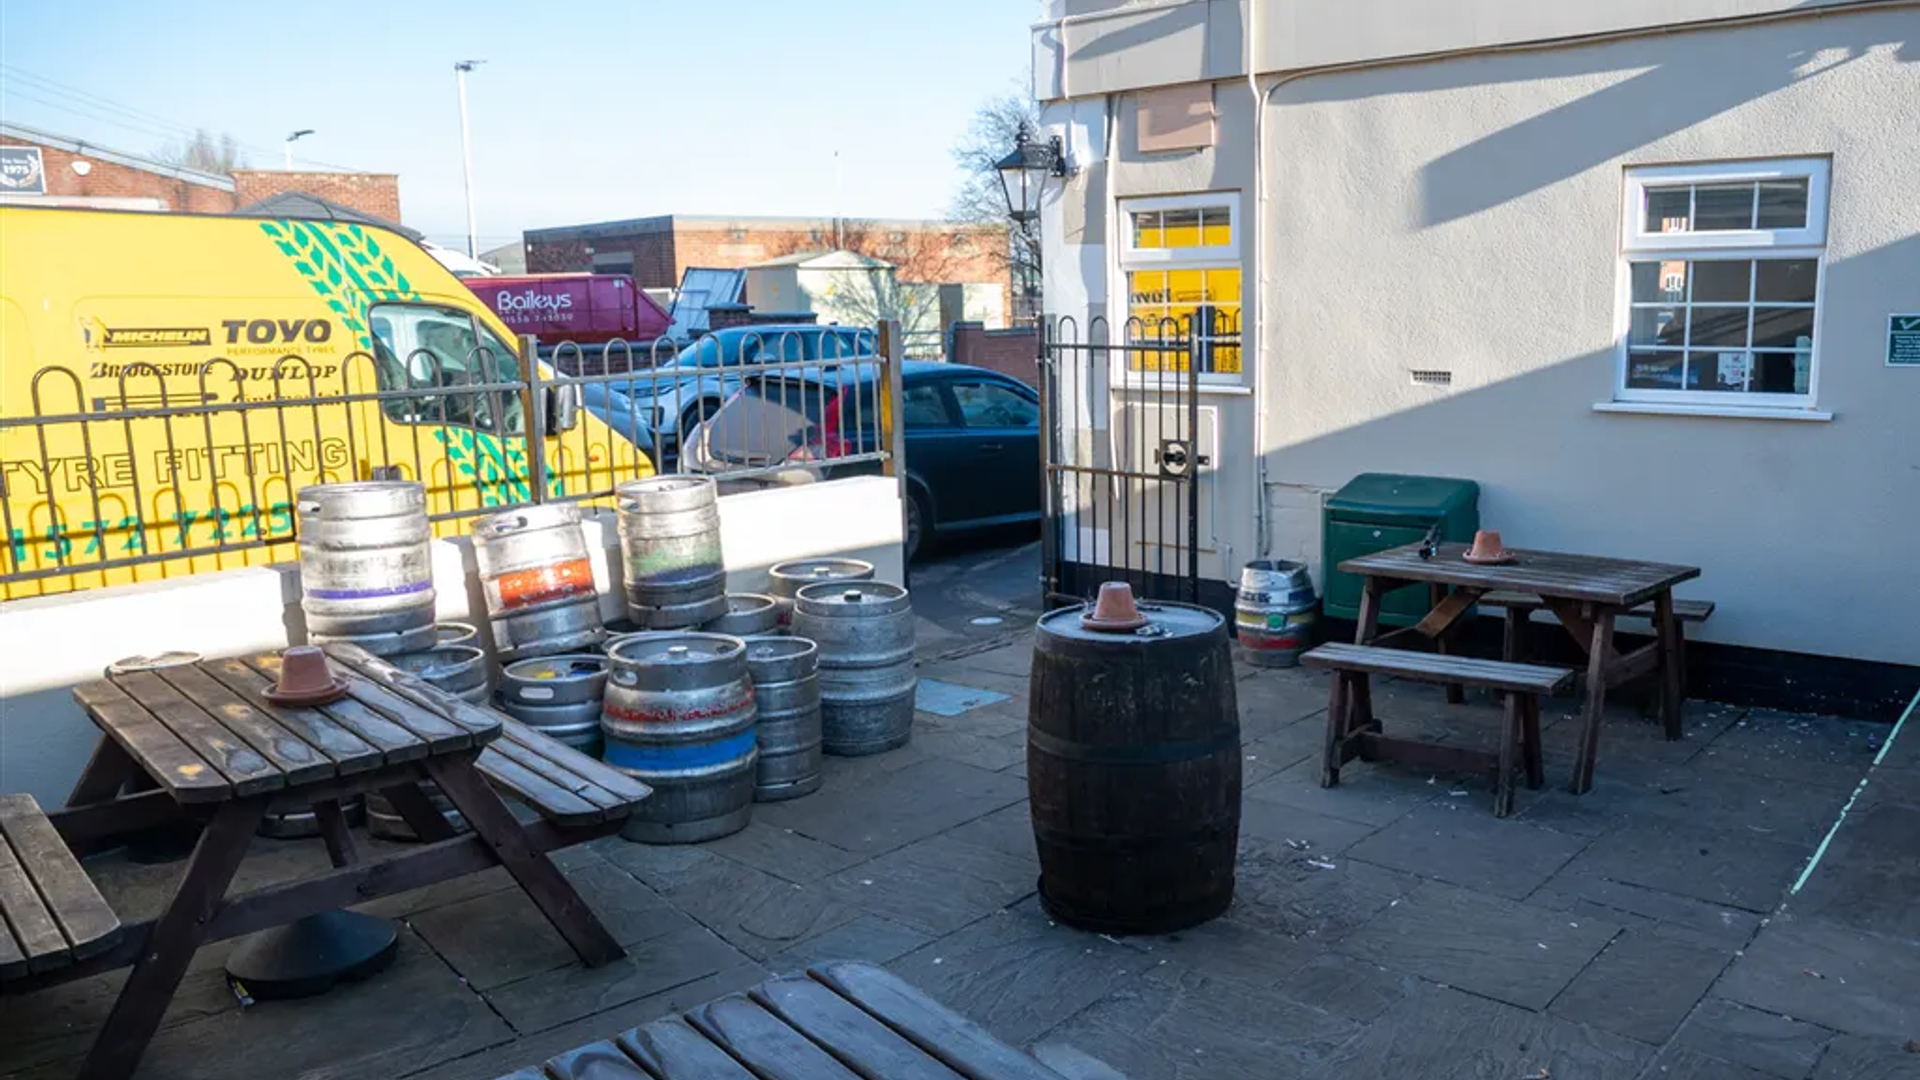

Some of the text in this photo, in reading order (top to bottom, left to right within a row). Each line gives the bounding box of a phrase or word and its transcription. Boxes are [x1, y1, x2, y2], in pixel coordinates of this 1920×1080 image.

[497, 289, 572, 312] Baileys
[111, 330, 208, 342] MICHELIN
[221, 319, 332, 344] TOYO
[229, 365, 338, 382] DUNLOP
[0, 437, 349, 497] TYRE FITTING
